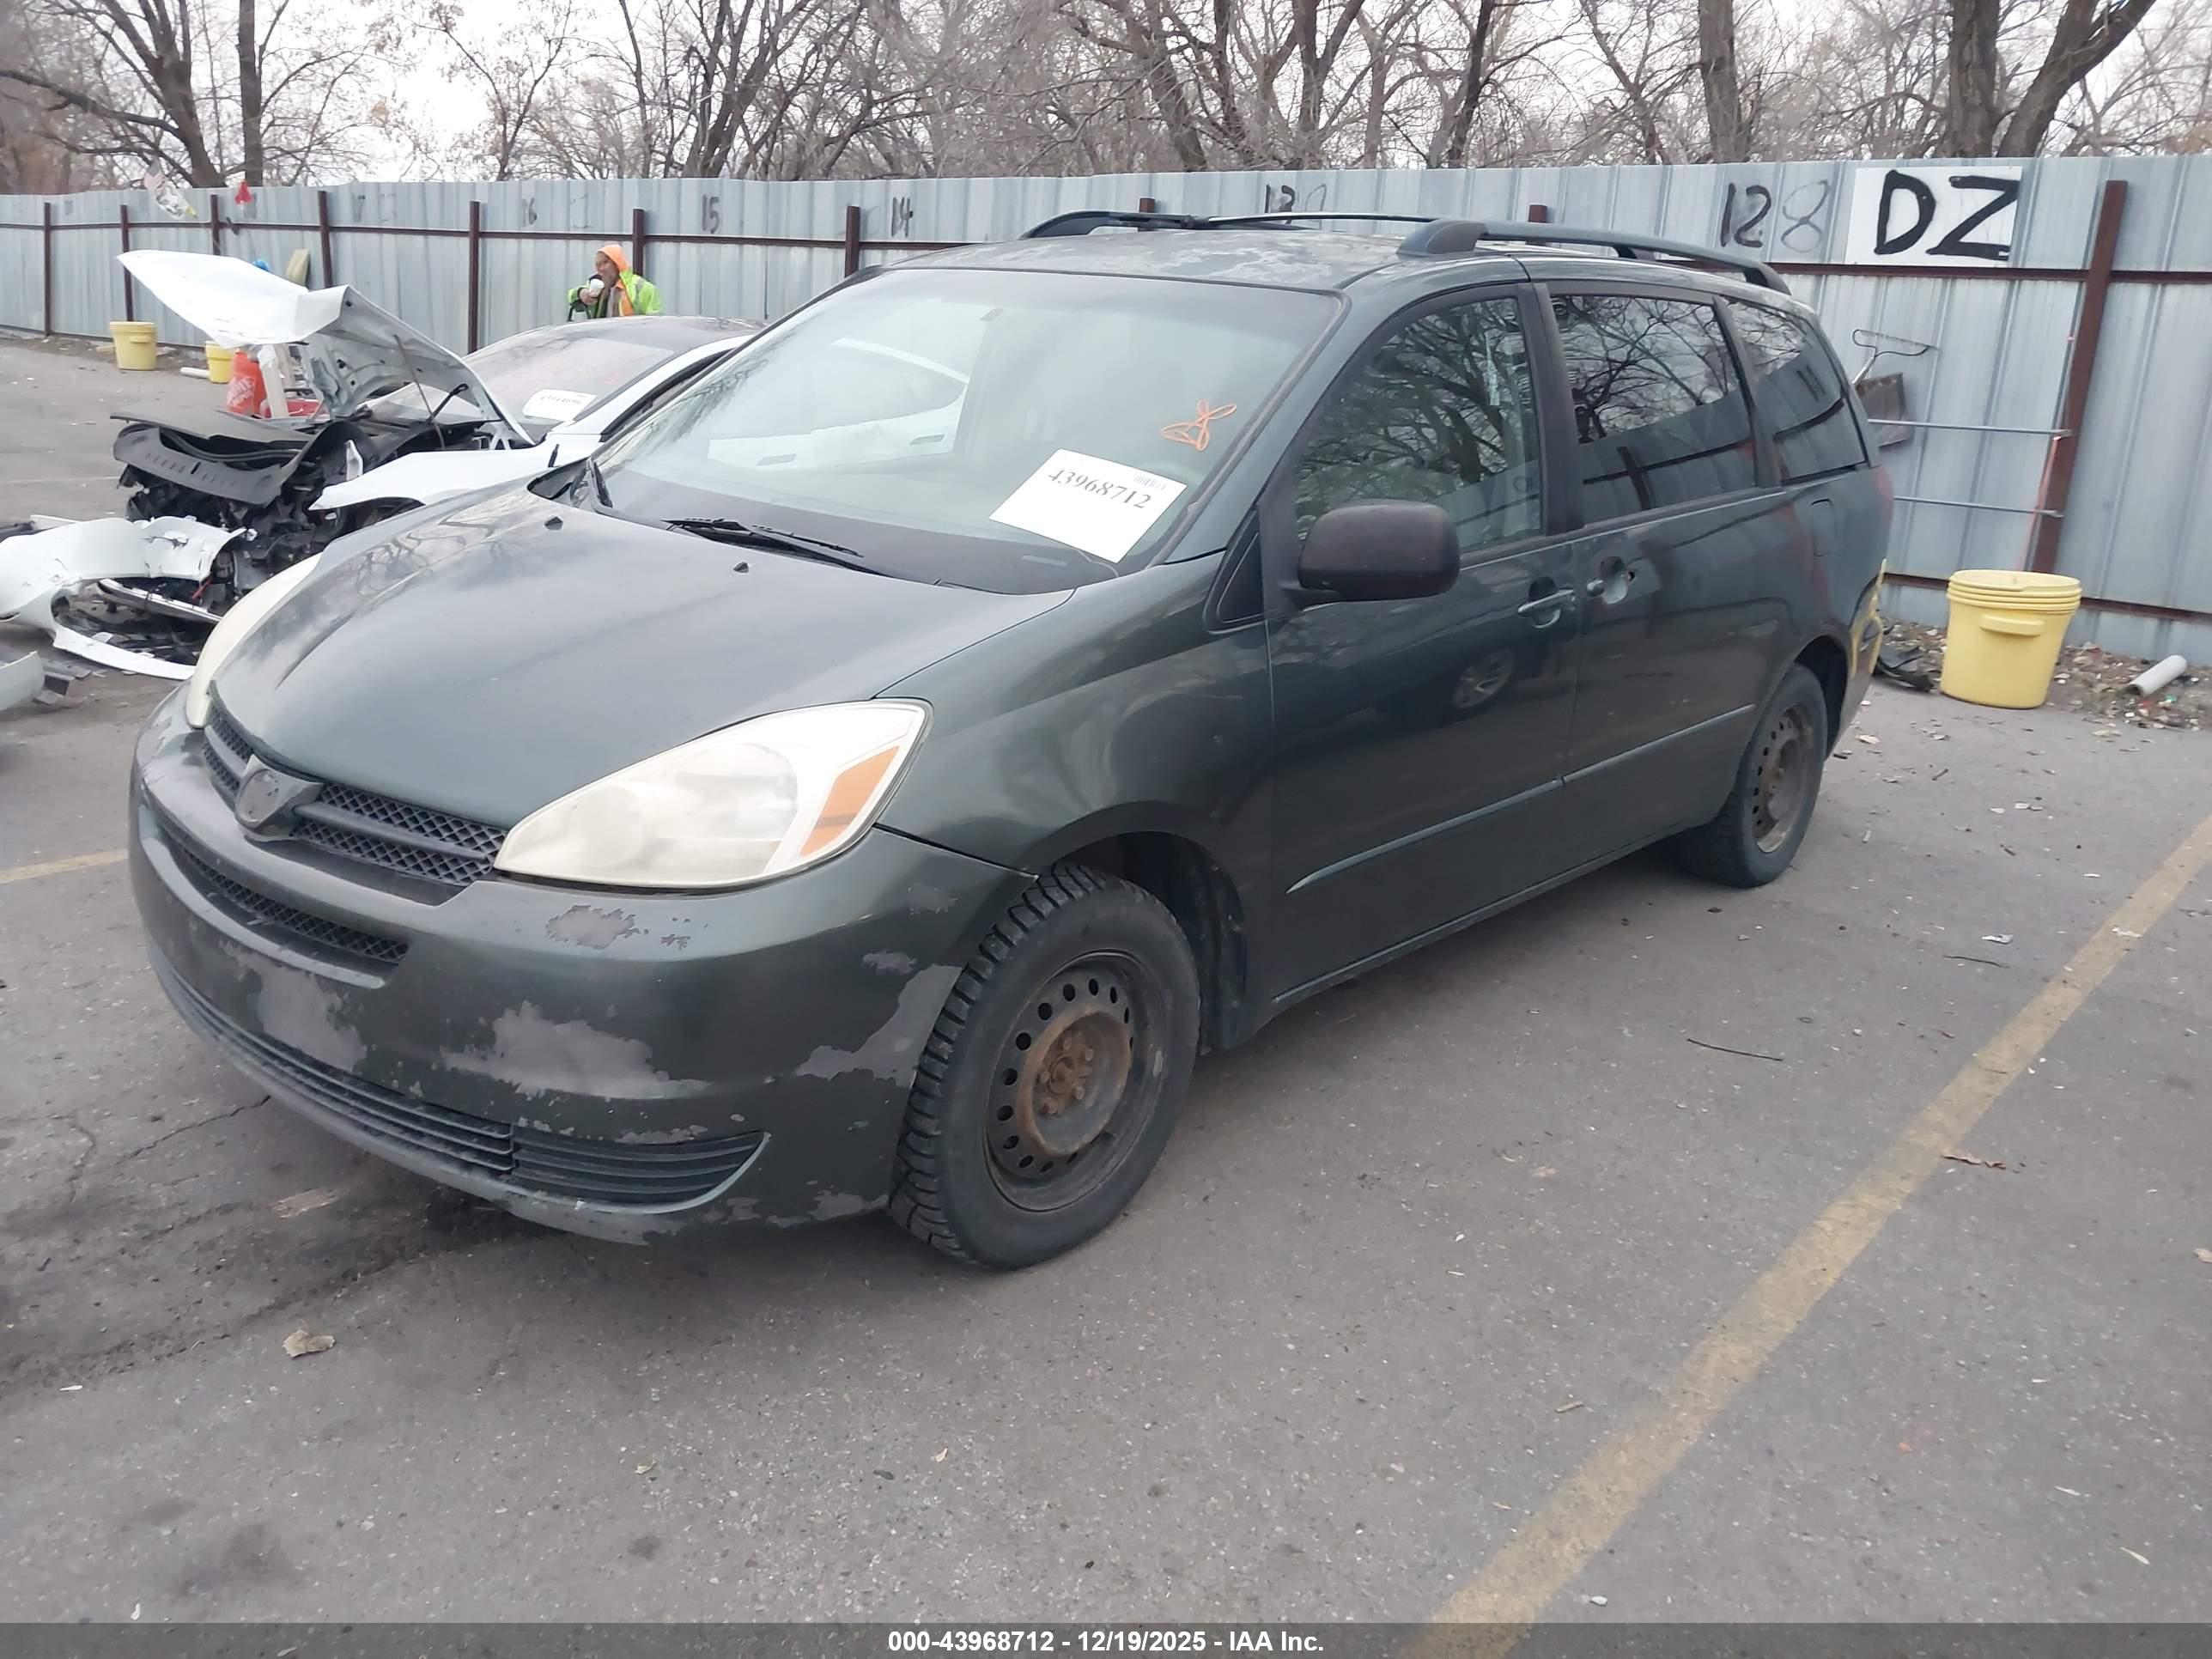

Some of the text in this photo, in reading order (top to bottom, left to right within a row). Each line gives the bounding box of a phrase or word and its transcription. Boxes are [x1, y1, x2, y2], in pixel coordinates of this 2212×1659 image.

[702, 194, 720, 234] 15
[890, 196, 914, 239] 14
[1874, 169, 2021, 262] DZ
[1048, 469, 1152, 508] 43968712
